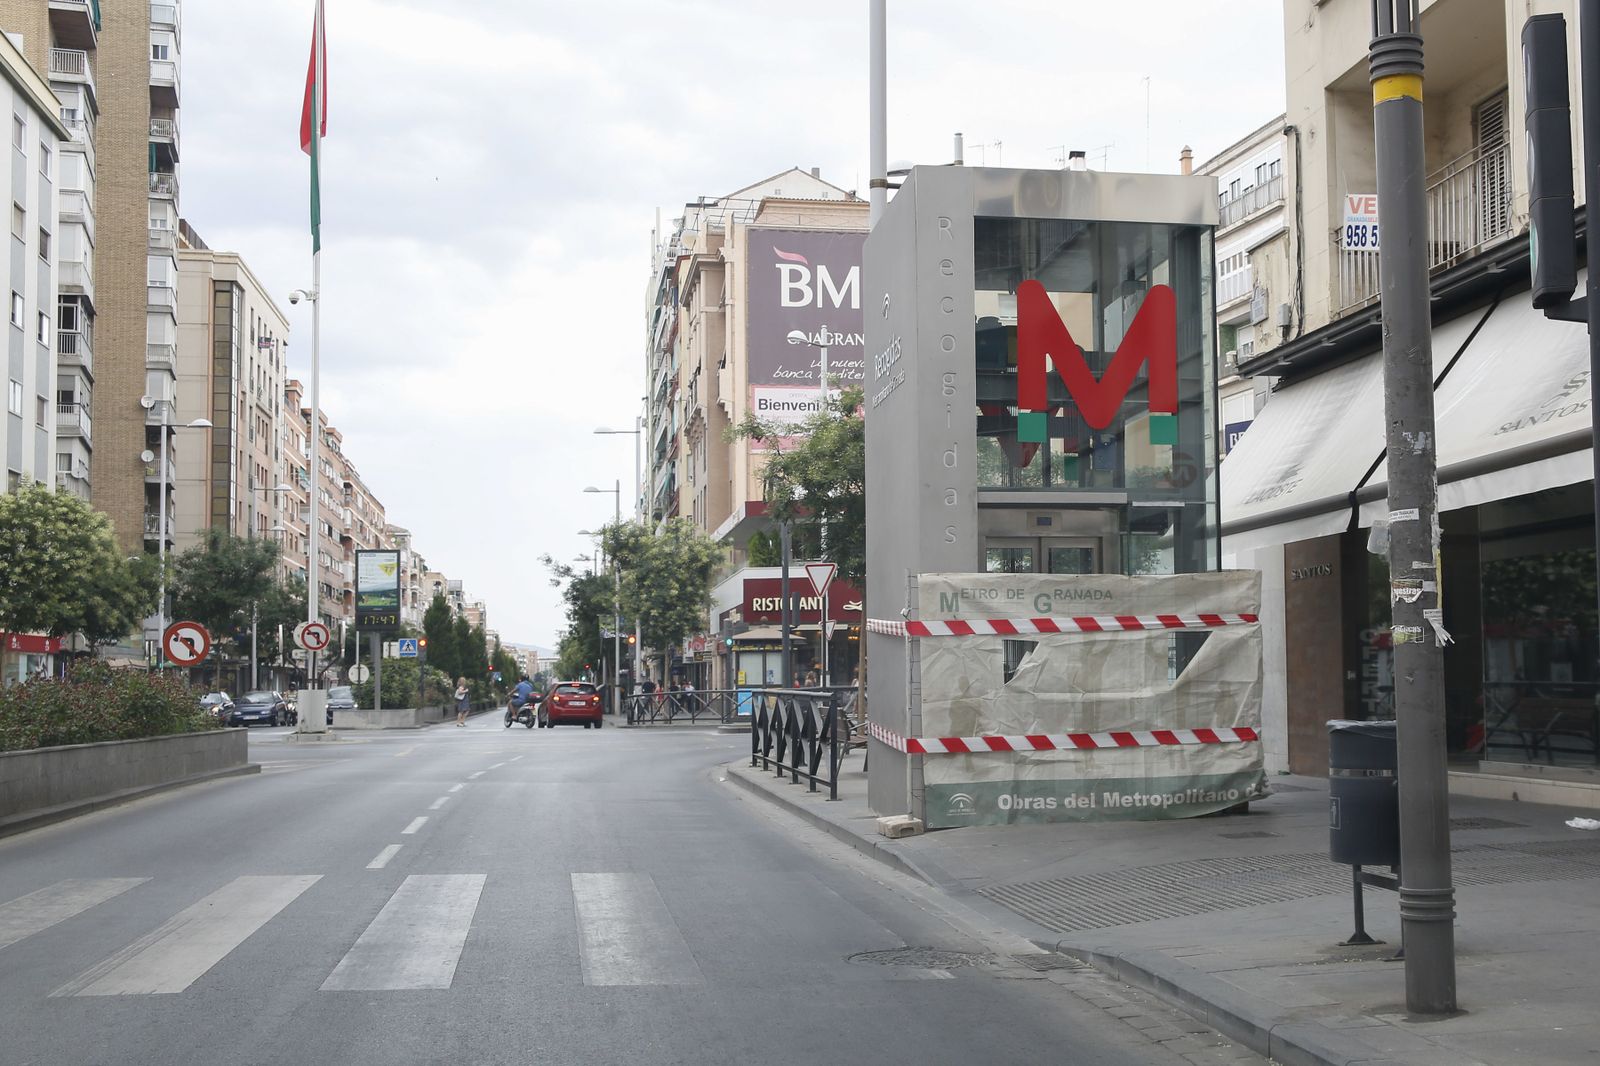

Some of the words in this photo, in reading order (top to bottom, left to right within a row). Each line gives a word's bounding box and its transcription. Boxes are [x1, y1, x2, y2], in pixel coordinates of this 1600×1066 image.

[1348, 197, 1377, 214] VE
[1346, 225, 1367, 247] 958
[1371, 225, 1380, 247] 5
[775, 263, 860, 309] BM
[787, 331, 864, 346] JAGRAN
[773, 365, 812, 379] banca
[817, 370, 864, 380] edite
[937, 216, 958, 544] Recogidas
[758, 399, 841, 412] Bienvenia
[1493, 399, 1591, 435] SANTOS
[1291, 563, 1331, 580] SANTOS
[940, 588, 998, 612] METRO
[1007, 589, 1025, 600] DE
[1034, 589, 1113, 613] GRANADA
[363, 615, 395, 624] 17:47
[998, 794, 1057, 809] Obras
[1065, 793, 1095, 808] del
[1103, 788, 1239, 809] Metropolitano
